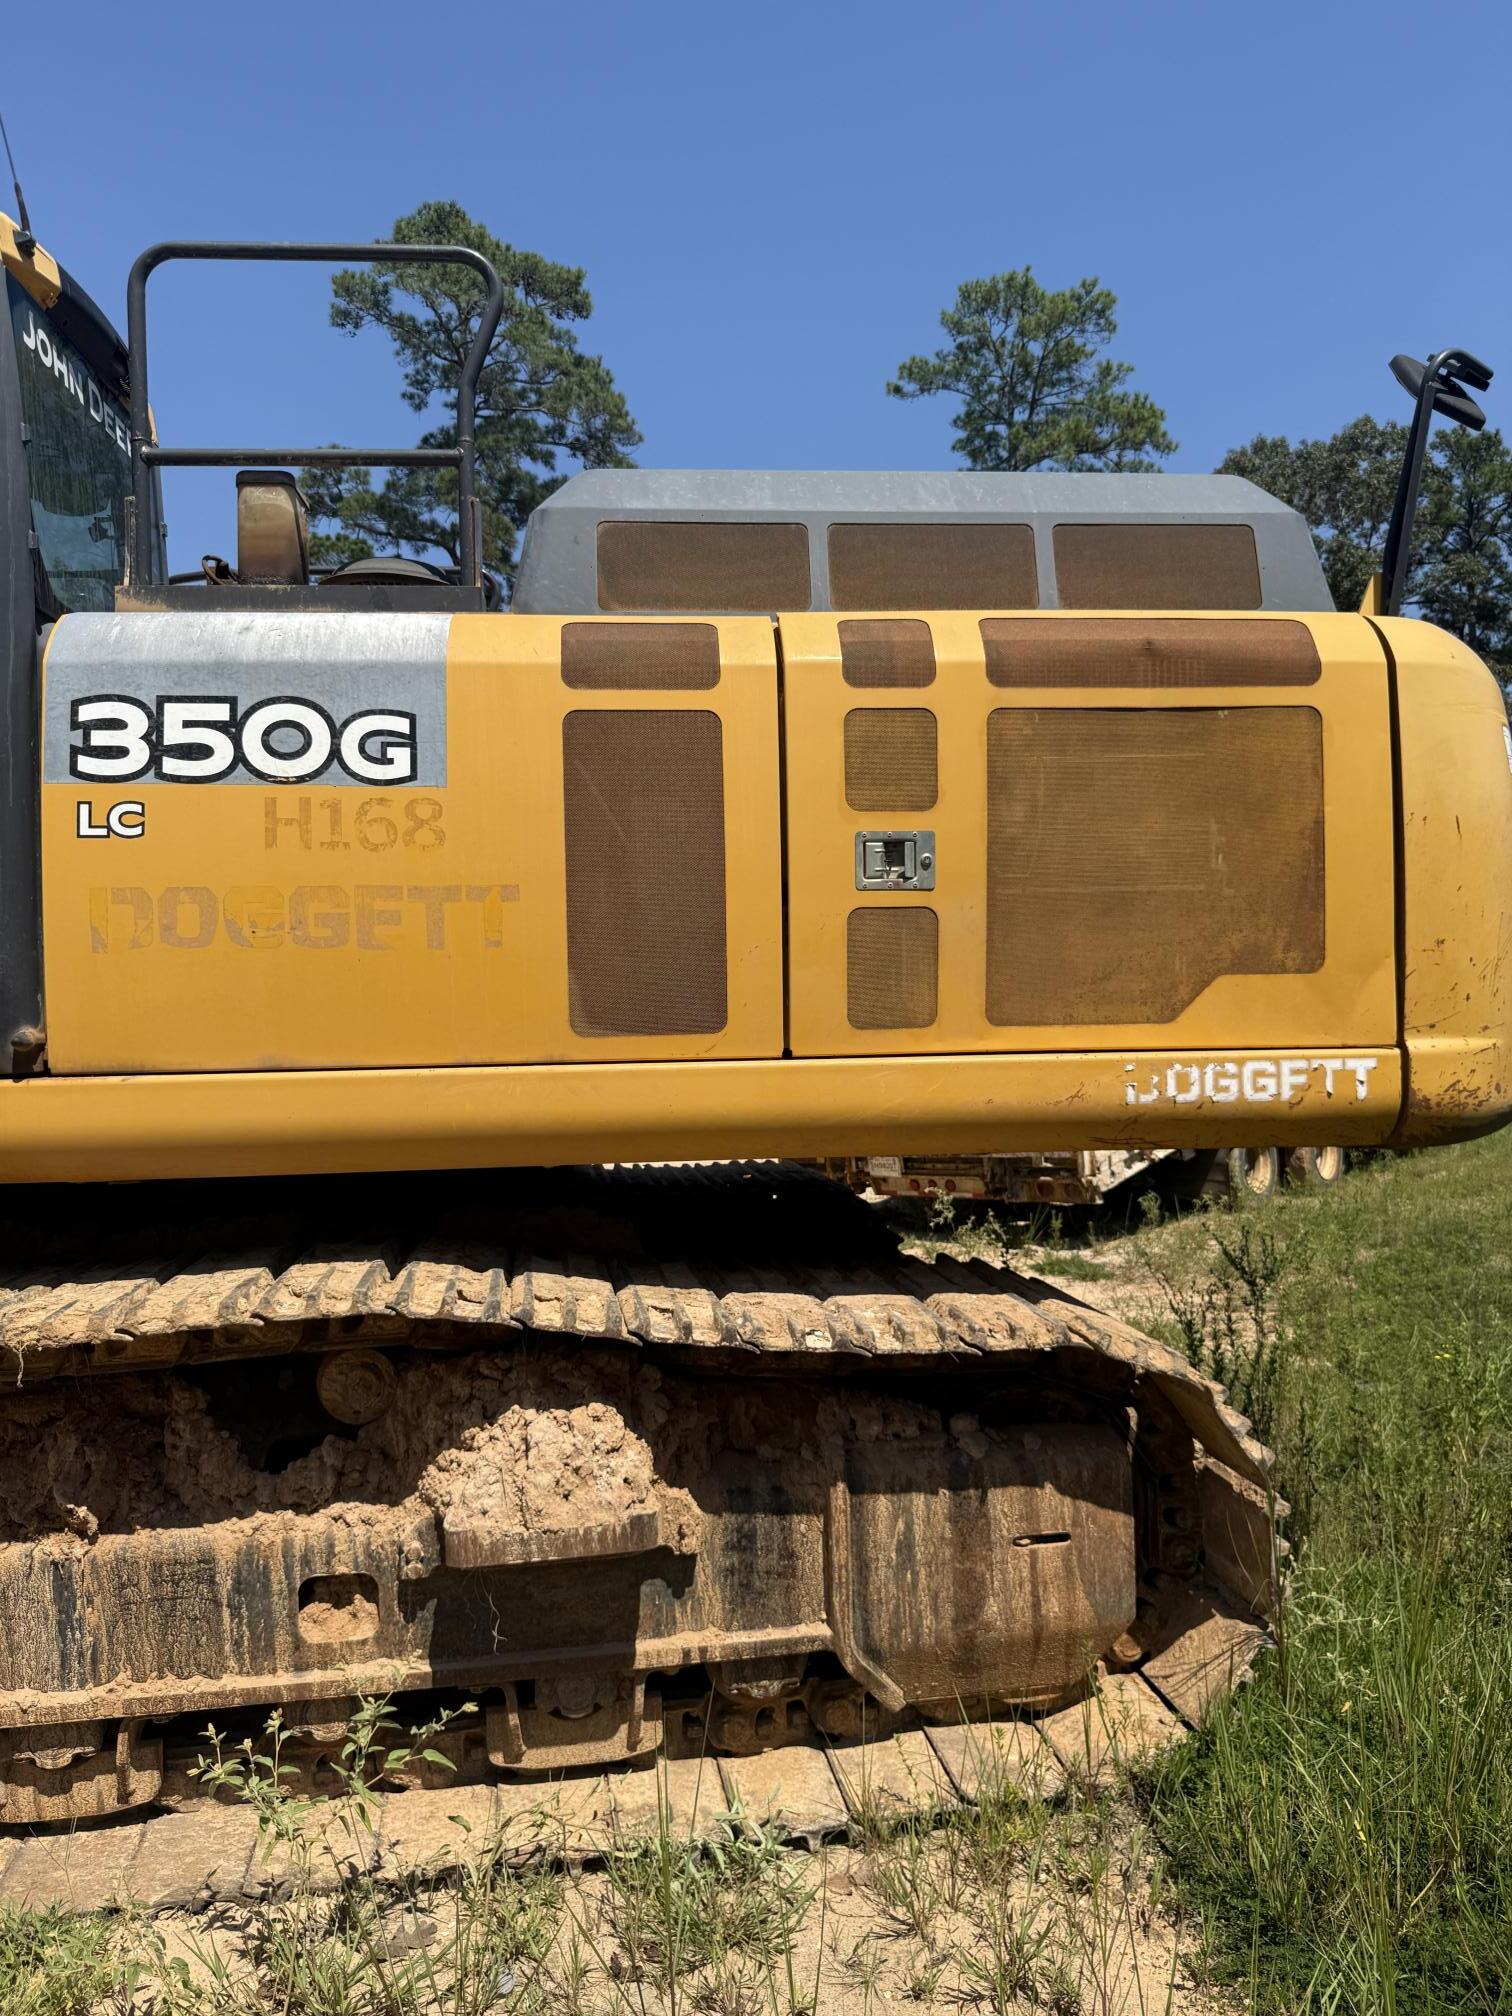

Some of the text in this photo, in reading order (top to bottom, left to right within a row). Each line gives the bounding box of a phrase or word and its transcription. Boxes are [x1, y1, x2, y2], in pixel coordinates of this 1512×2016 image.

[23, 310, 132, 458] JOHN DEE
[70, 694, 417, 786] 350G
[76, 801, 145, 838] LC
[265, 797, 446, 851] H168
